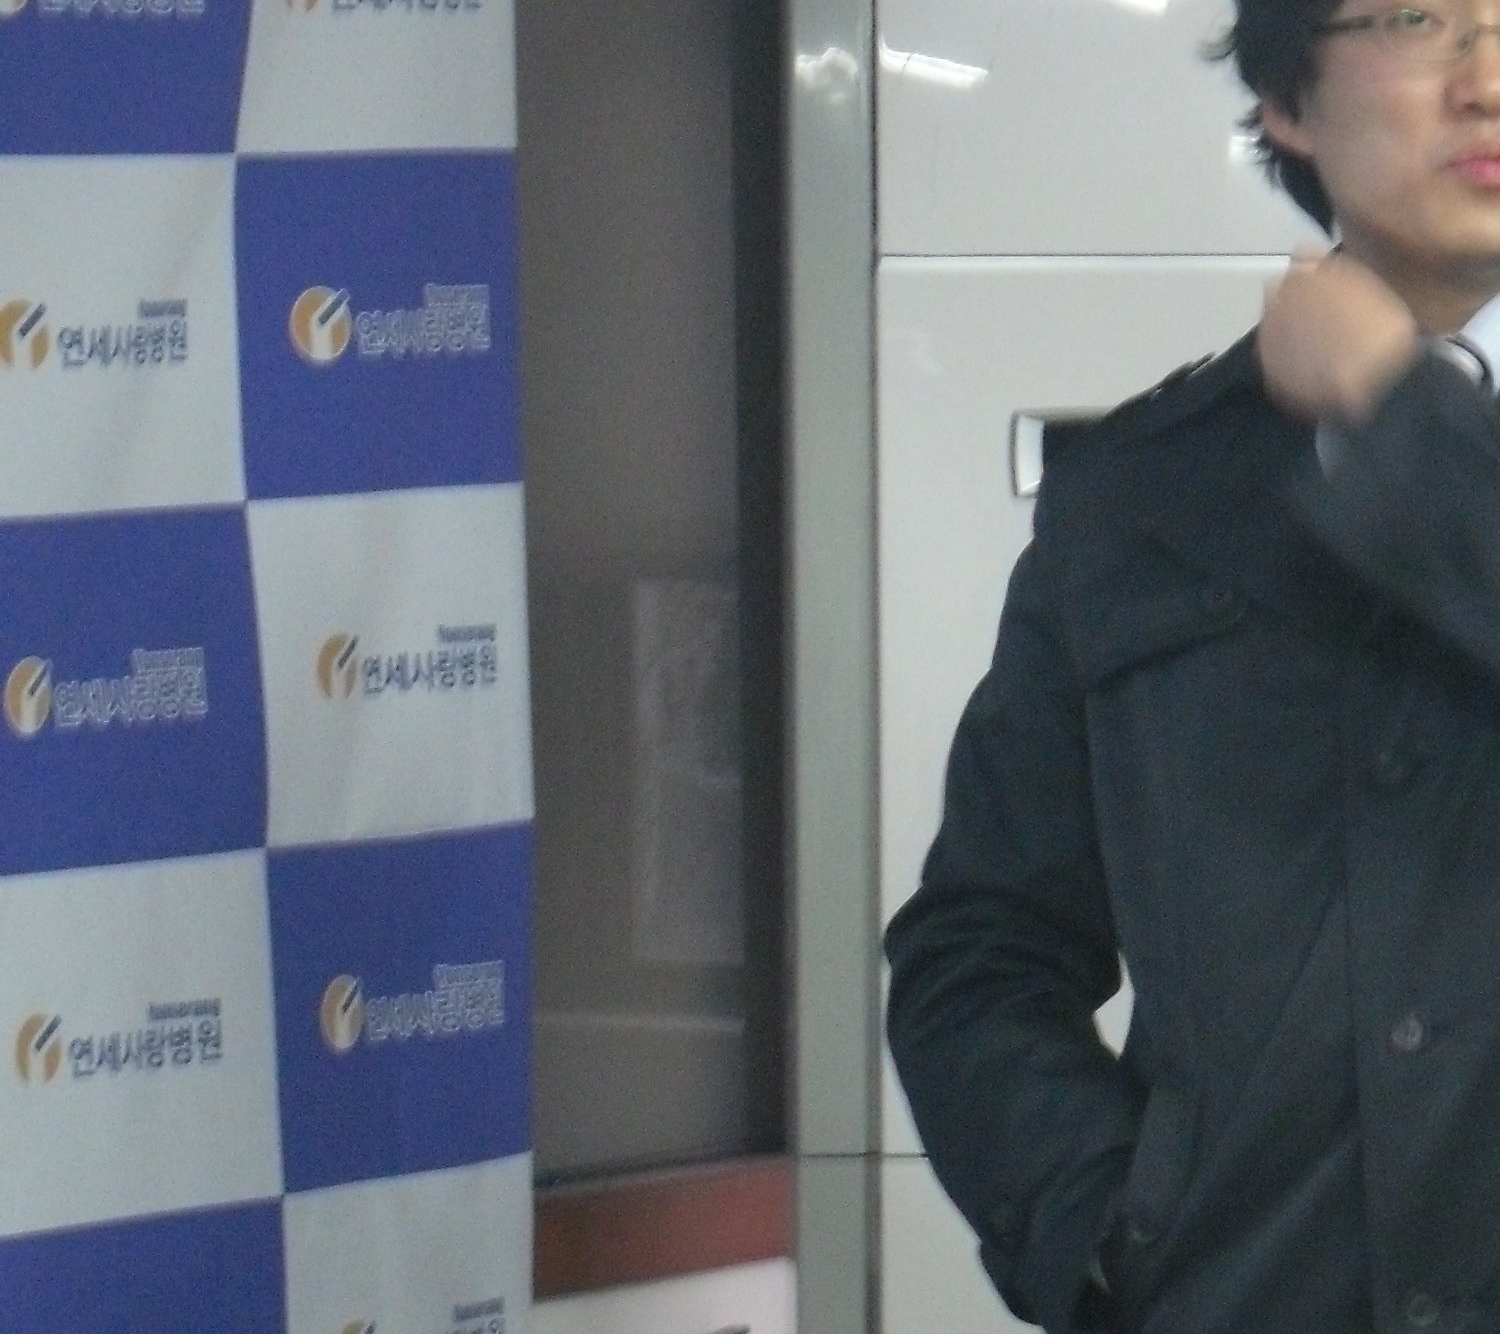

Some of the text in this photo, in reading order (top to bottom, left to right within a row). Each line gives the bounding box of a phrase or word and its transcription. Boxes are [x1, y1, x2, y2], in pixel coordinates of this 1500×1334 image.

[57, 318, 189, 368] 연세사랑병원
[362, 646, 498, 697] 연세사랑병원
[71, 1019, 223, 1078] 연세사랑병원
